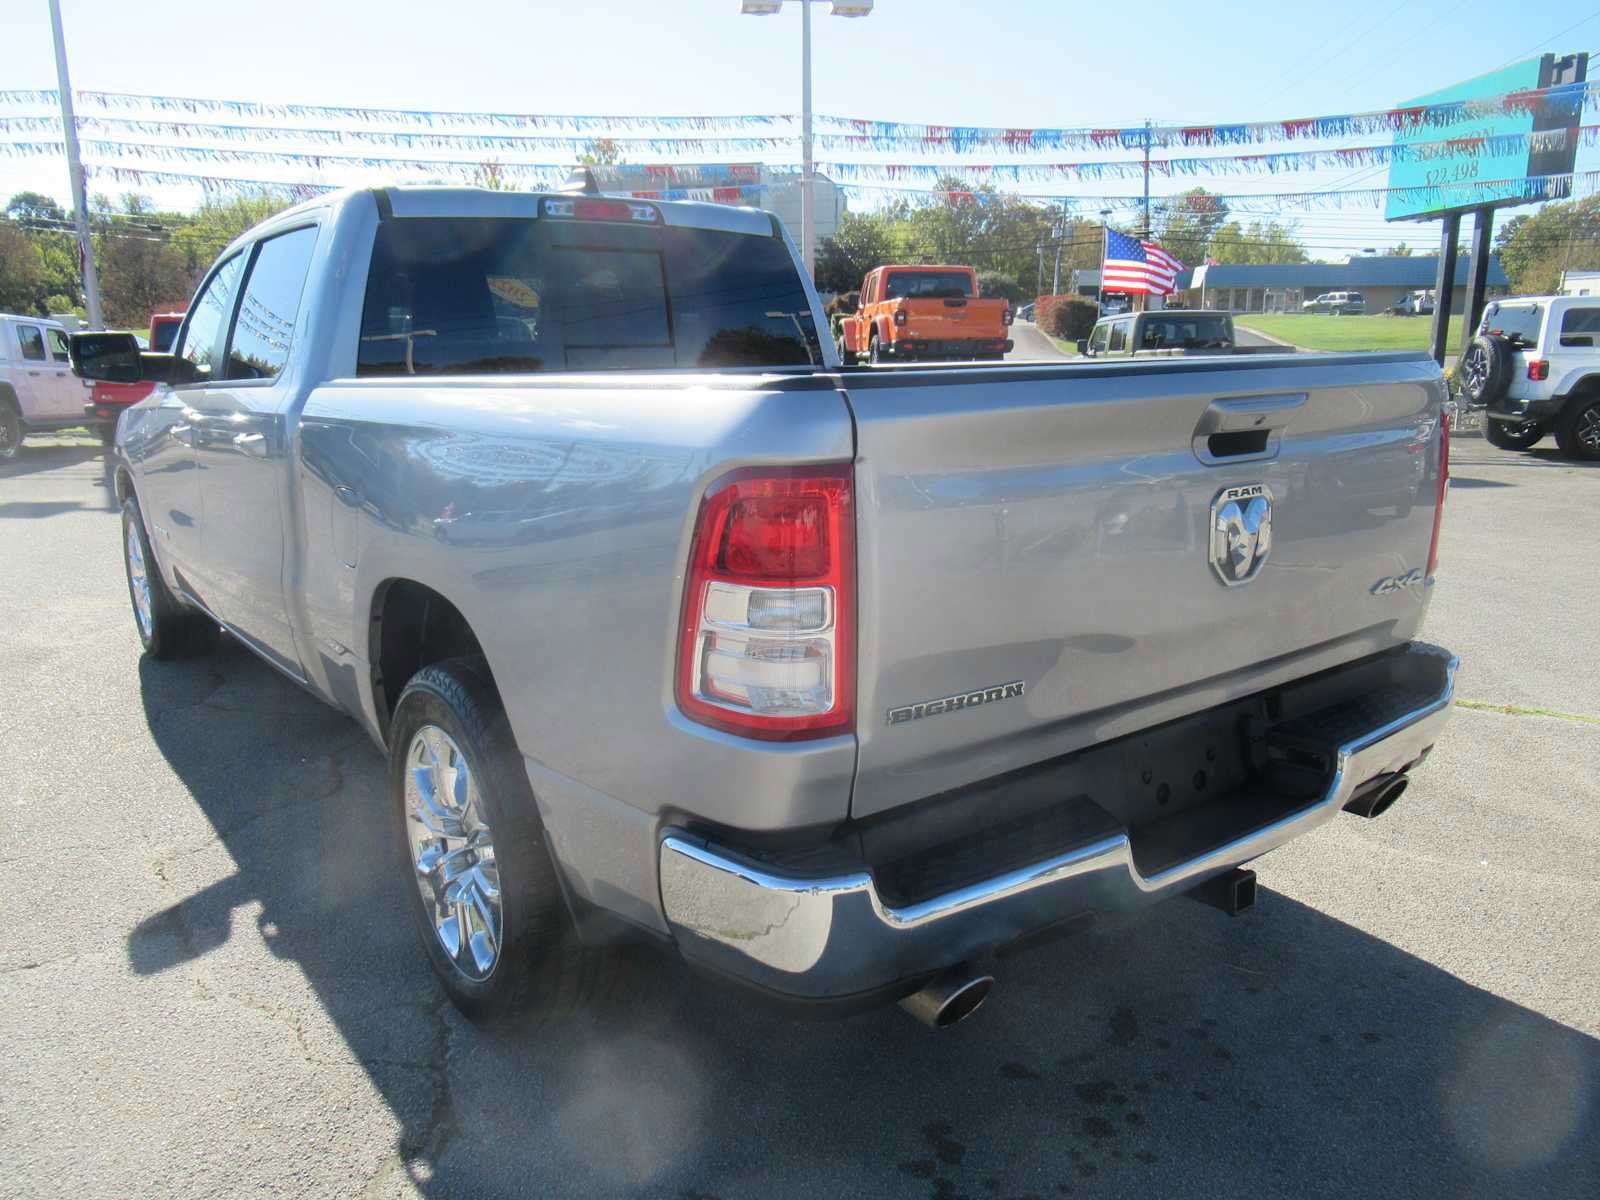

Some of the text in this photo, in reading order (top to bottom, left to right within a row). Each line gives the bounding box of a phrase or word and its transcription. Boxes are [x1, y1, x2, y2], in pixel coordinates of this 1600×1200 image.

[1426, 159, 1479, 186] $22,498
[1228, 485, 1263, 499] RAM
[887, 680, 1025, 725] BIGHORN
